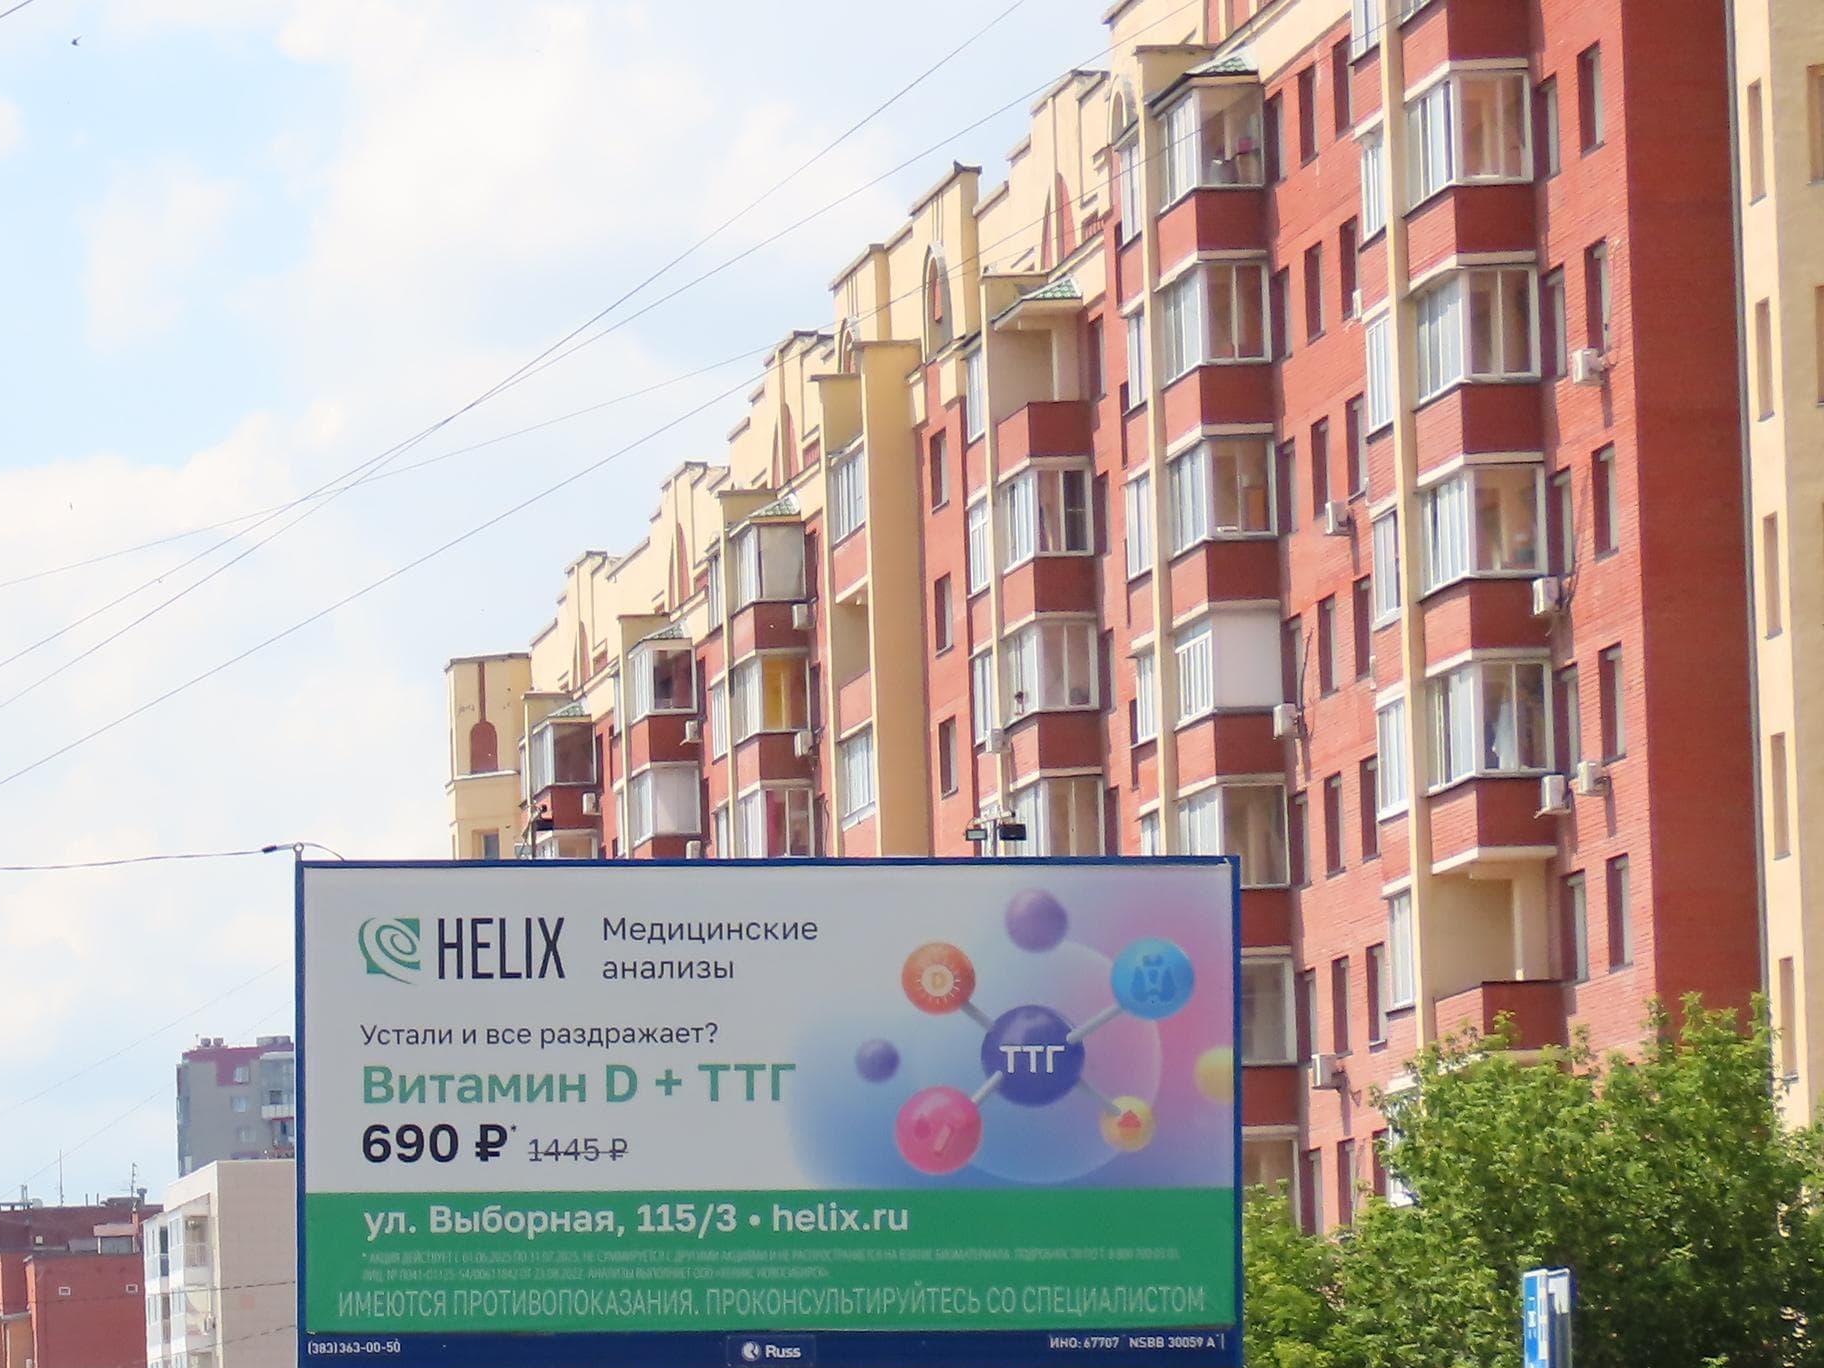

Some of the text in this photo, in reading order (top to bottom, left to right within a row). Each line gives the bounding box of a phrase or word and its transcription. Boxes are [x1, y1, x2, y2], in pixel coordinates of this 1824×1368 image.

[602, 916, 819, 943] Медицинские
[437, 917, 566, 980] HELIX
[602, 957, 735, 979] анализы
[360, 1022, 719, 1049] Устали и все раздражает?
[999, 1044, 1065, 1074] ТТГ
[362, 1063, 797, 1104] Витамин D + ТТГ
[361, 1122, 460, 1163] 690
[527, 1138, 601, 1163] 1445
[364, 1202, 738, 1241] ул. Выборная, 115/3
[772, 1202, 909, 1232] helix.ru
[338, 1281, 1205, 1317] ИМЕЮТСЯ ПРОТИВОПОКАЗАНИЯ. ПРОКОНСУЛЬТИРУЙТЕСЬ СО СПЕЦИАЛИСТОМ
[765, 1343, 802, 1359] Russ
